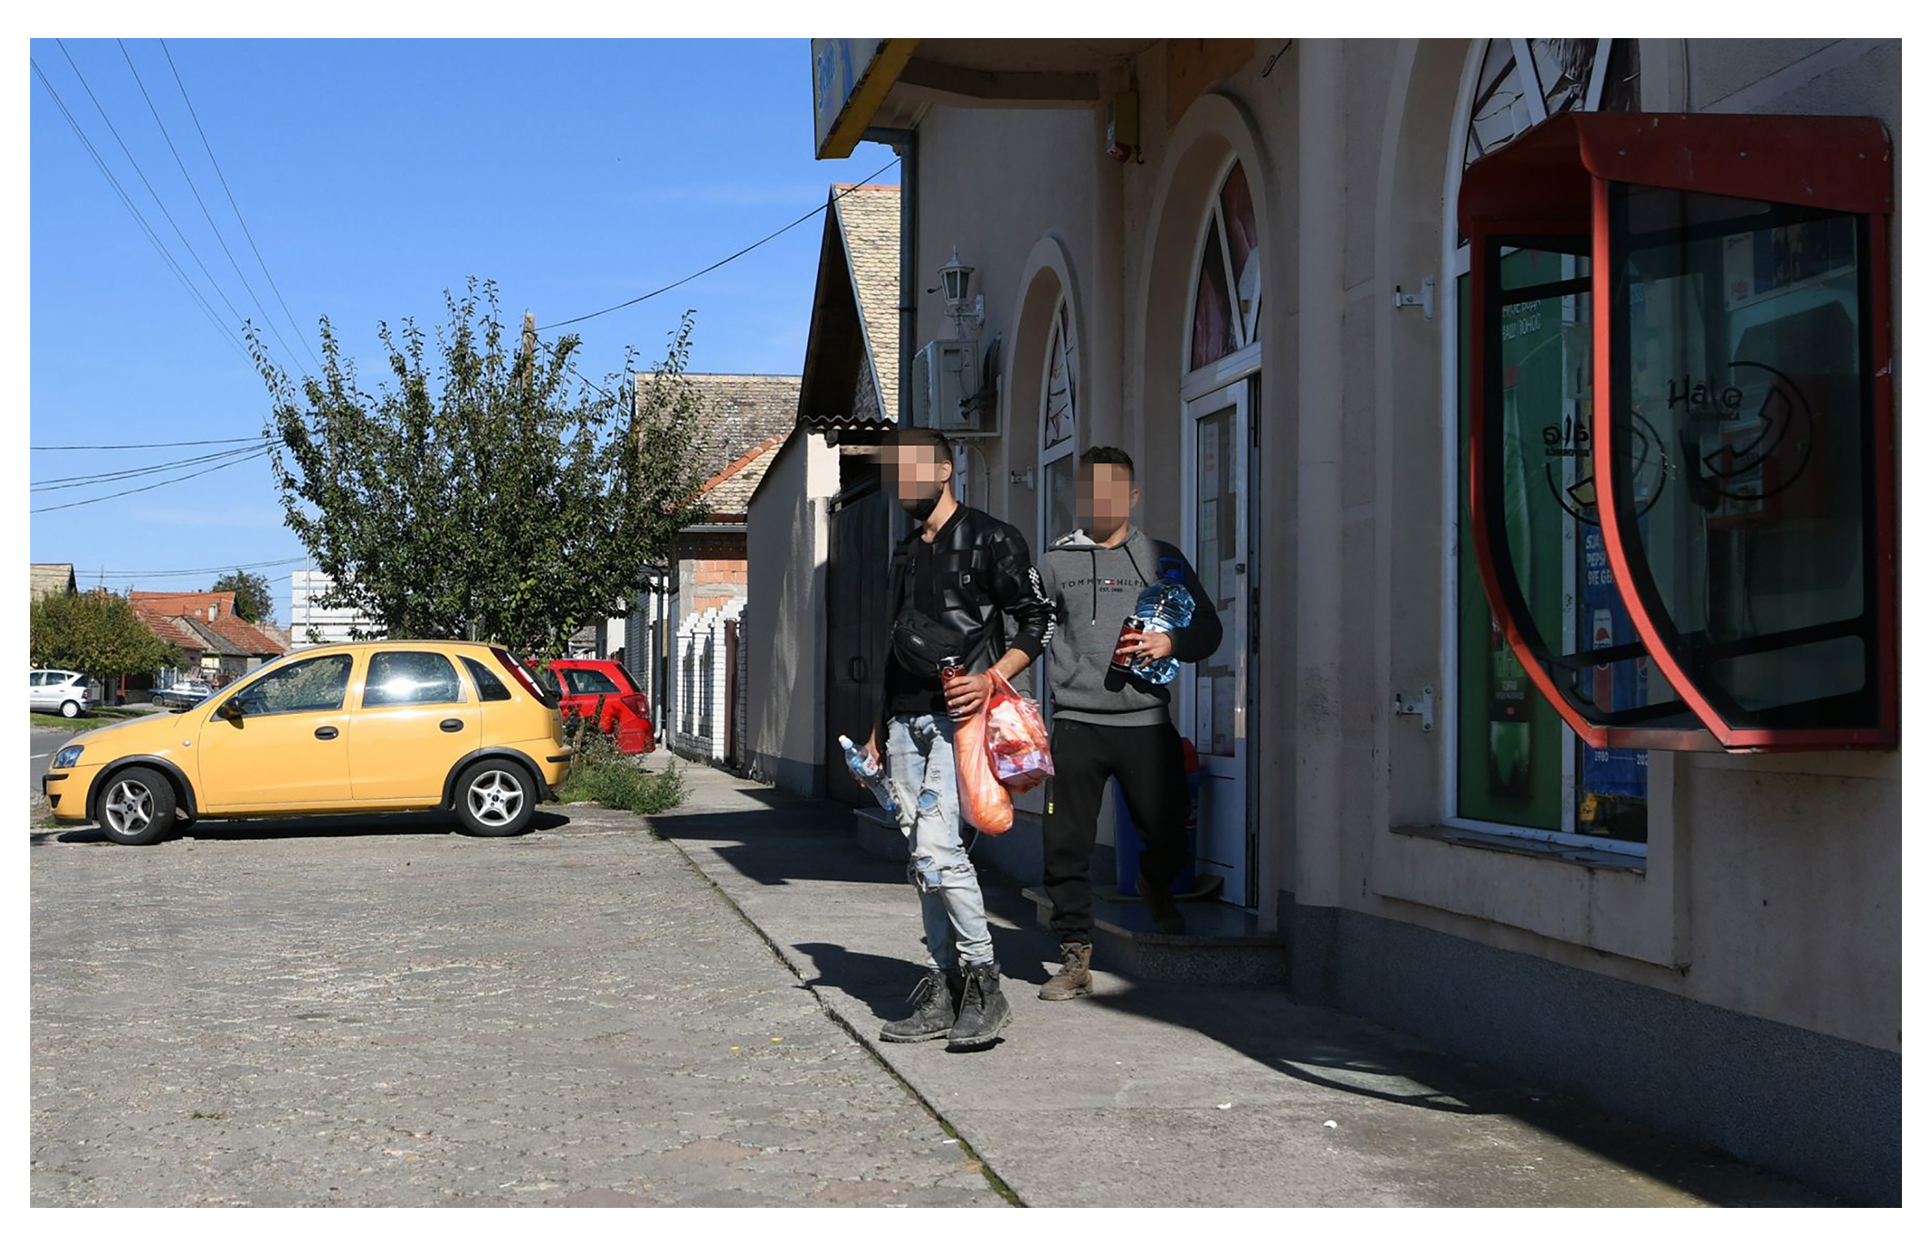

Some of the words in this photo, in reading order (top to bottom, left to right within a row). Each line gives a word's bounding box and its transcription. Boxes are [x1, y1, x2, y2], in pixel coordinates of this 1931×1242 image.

[1601, 569, 1615, 584] GE
[1061, 579, 1102, 589] TOMMY
[1117, 579, 1145, 588] HILFI
